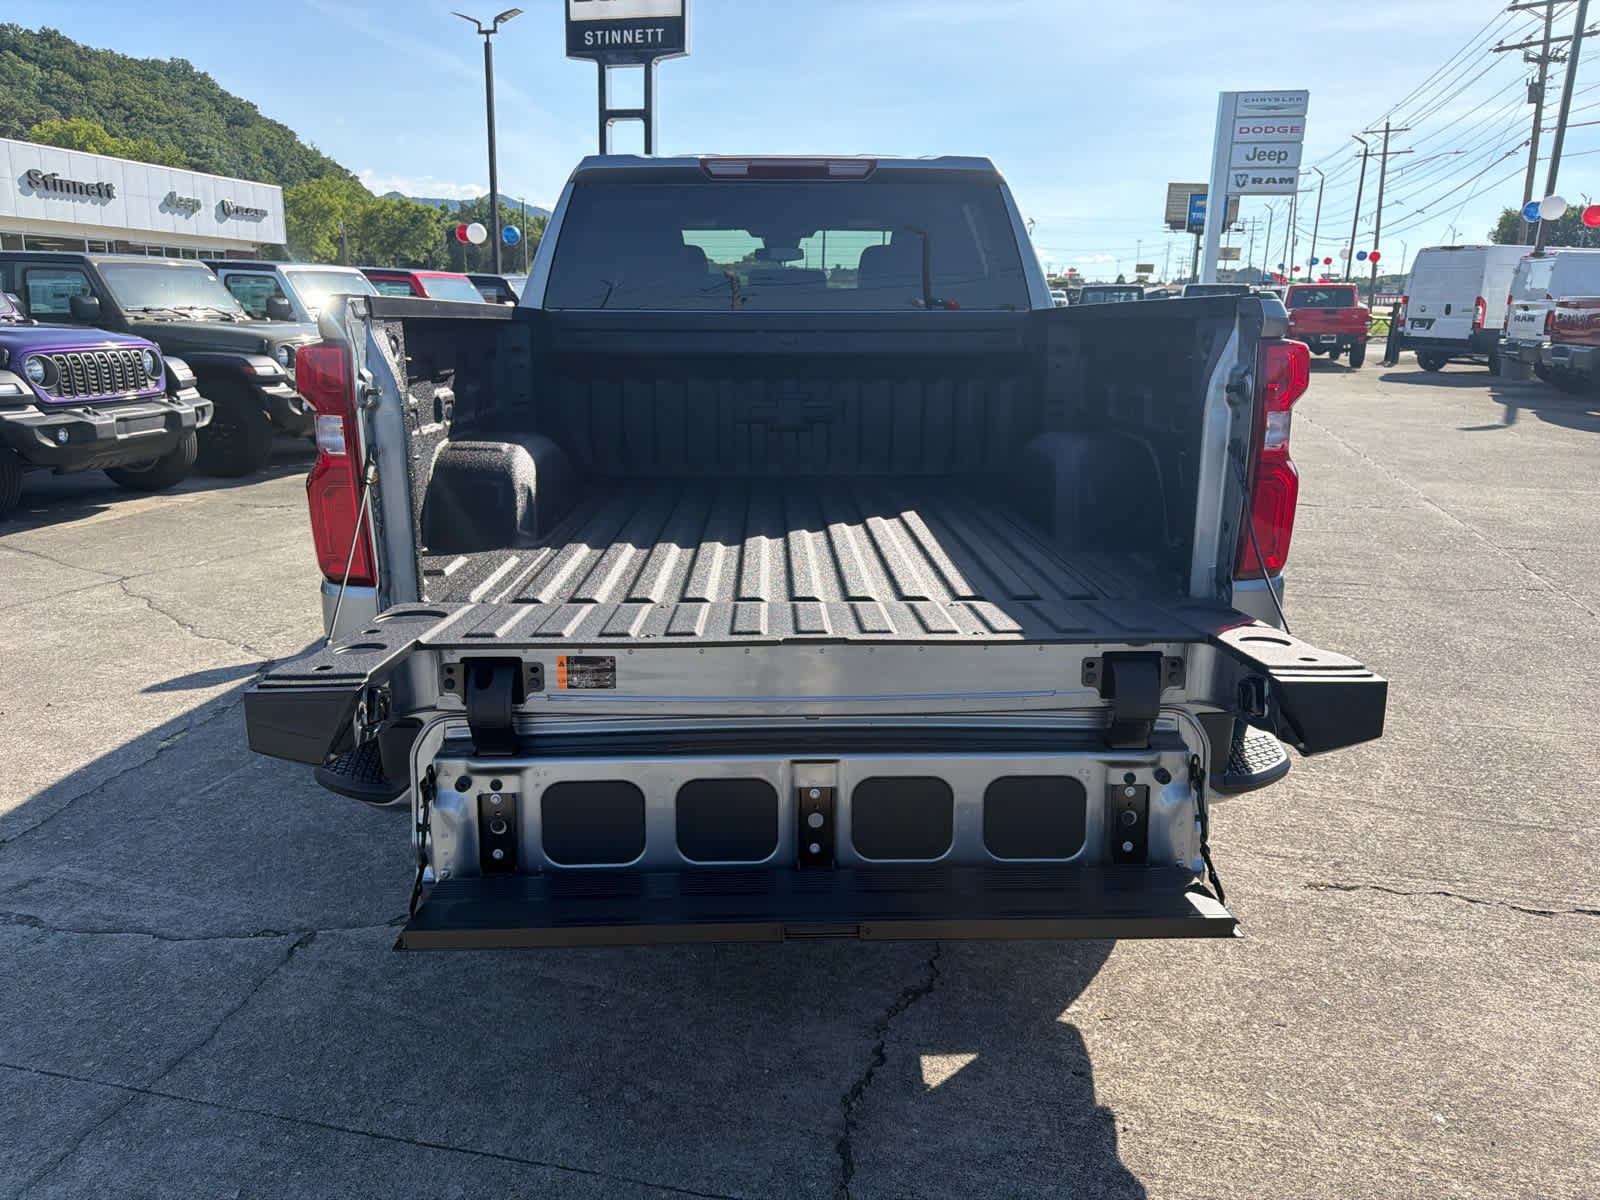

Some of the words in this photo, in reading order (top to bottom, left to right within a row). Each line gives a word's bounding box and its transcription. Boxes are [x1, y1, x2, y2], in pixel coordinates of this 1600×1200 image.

[584, 28, 665, 46] STINNETT
[1239, 126, 1302, 135] DODGE
[1245, 147, 1289, 164] Jeep
[27, 168, 116, 200] Stinnett
[1251, 177, 1295, 185] RAM
